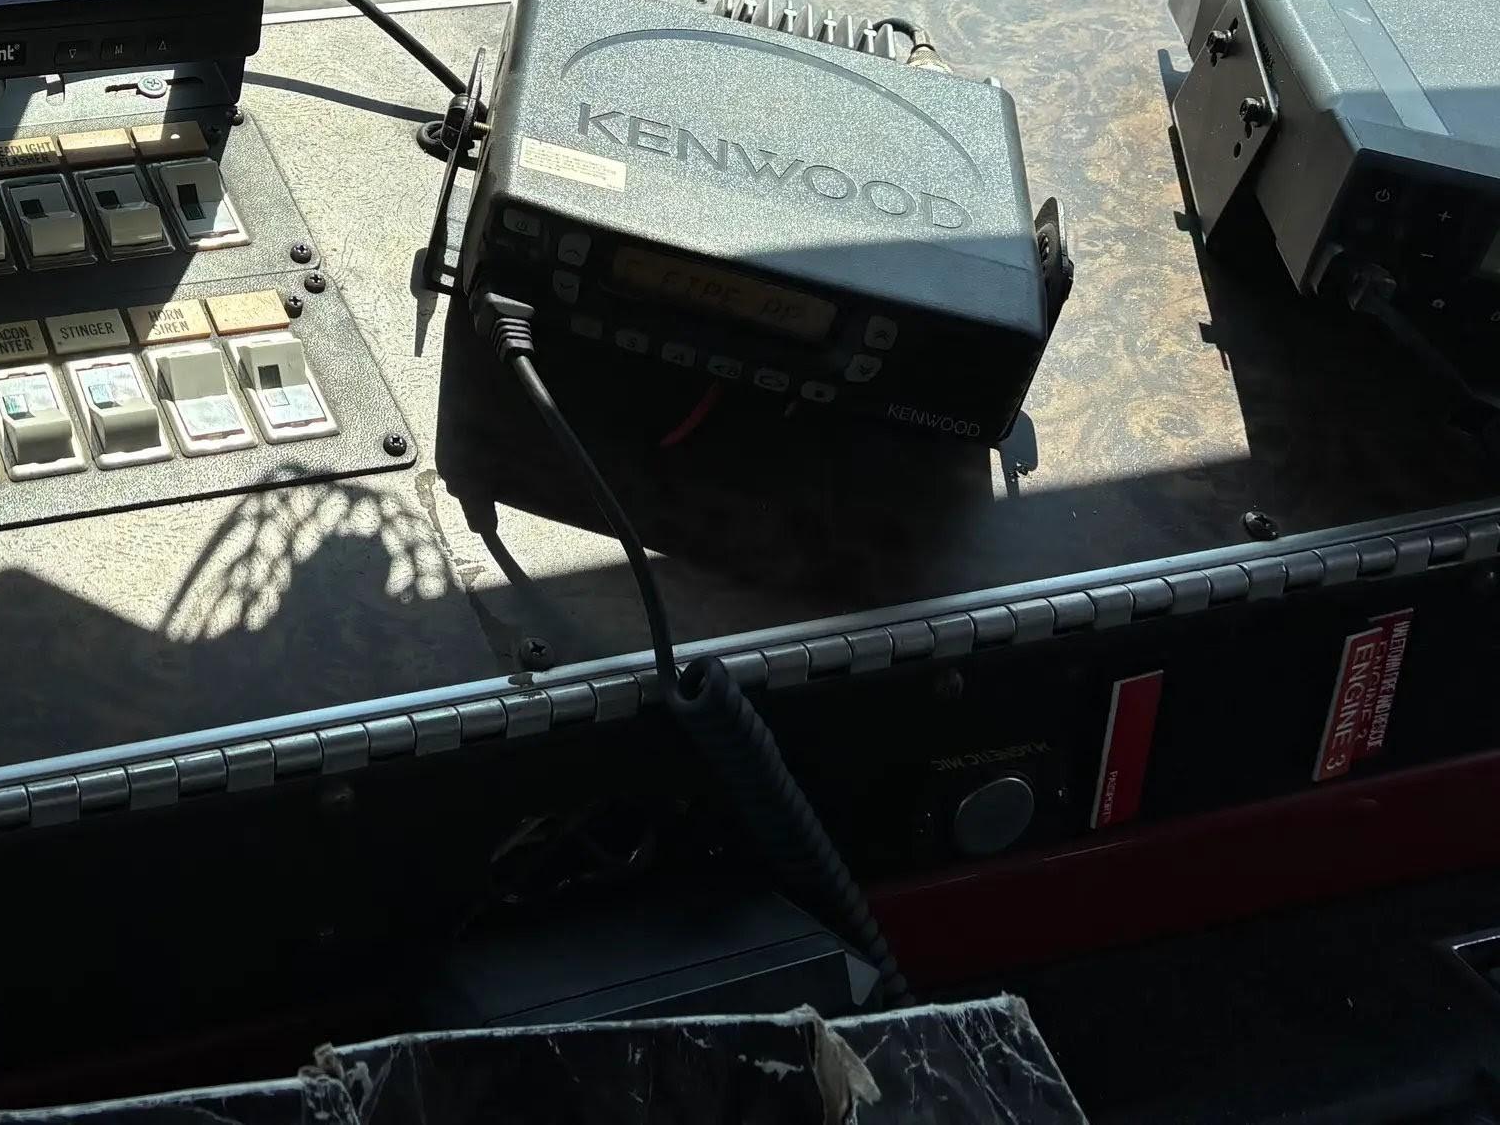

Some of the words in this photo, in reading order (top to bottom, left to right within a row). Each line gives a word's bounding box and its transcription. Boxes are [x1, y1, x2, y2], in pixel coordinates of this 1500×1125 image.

[0, 153, 51, 168] FLASHER
[577, 102, 974, 231] KENWOOD
[148, 307, 185, 322] HORN
[59, 321, 115, 340] STINGER
[152, 320, 190, 336] SIREN
[887, 403, 981, 437] KENWOOD
[1333, 641, 1376, 749] ENGINE
[1326, 754, 1346, 771] 3
